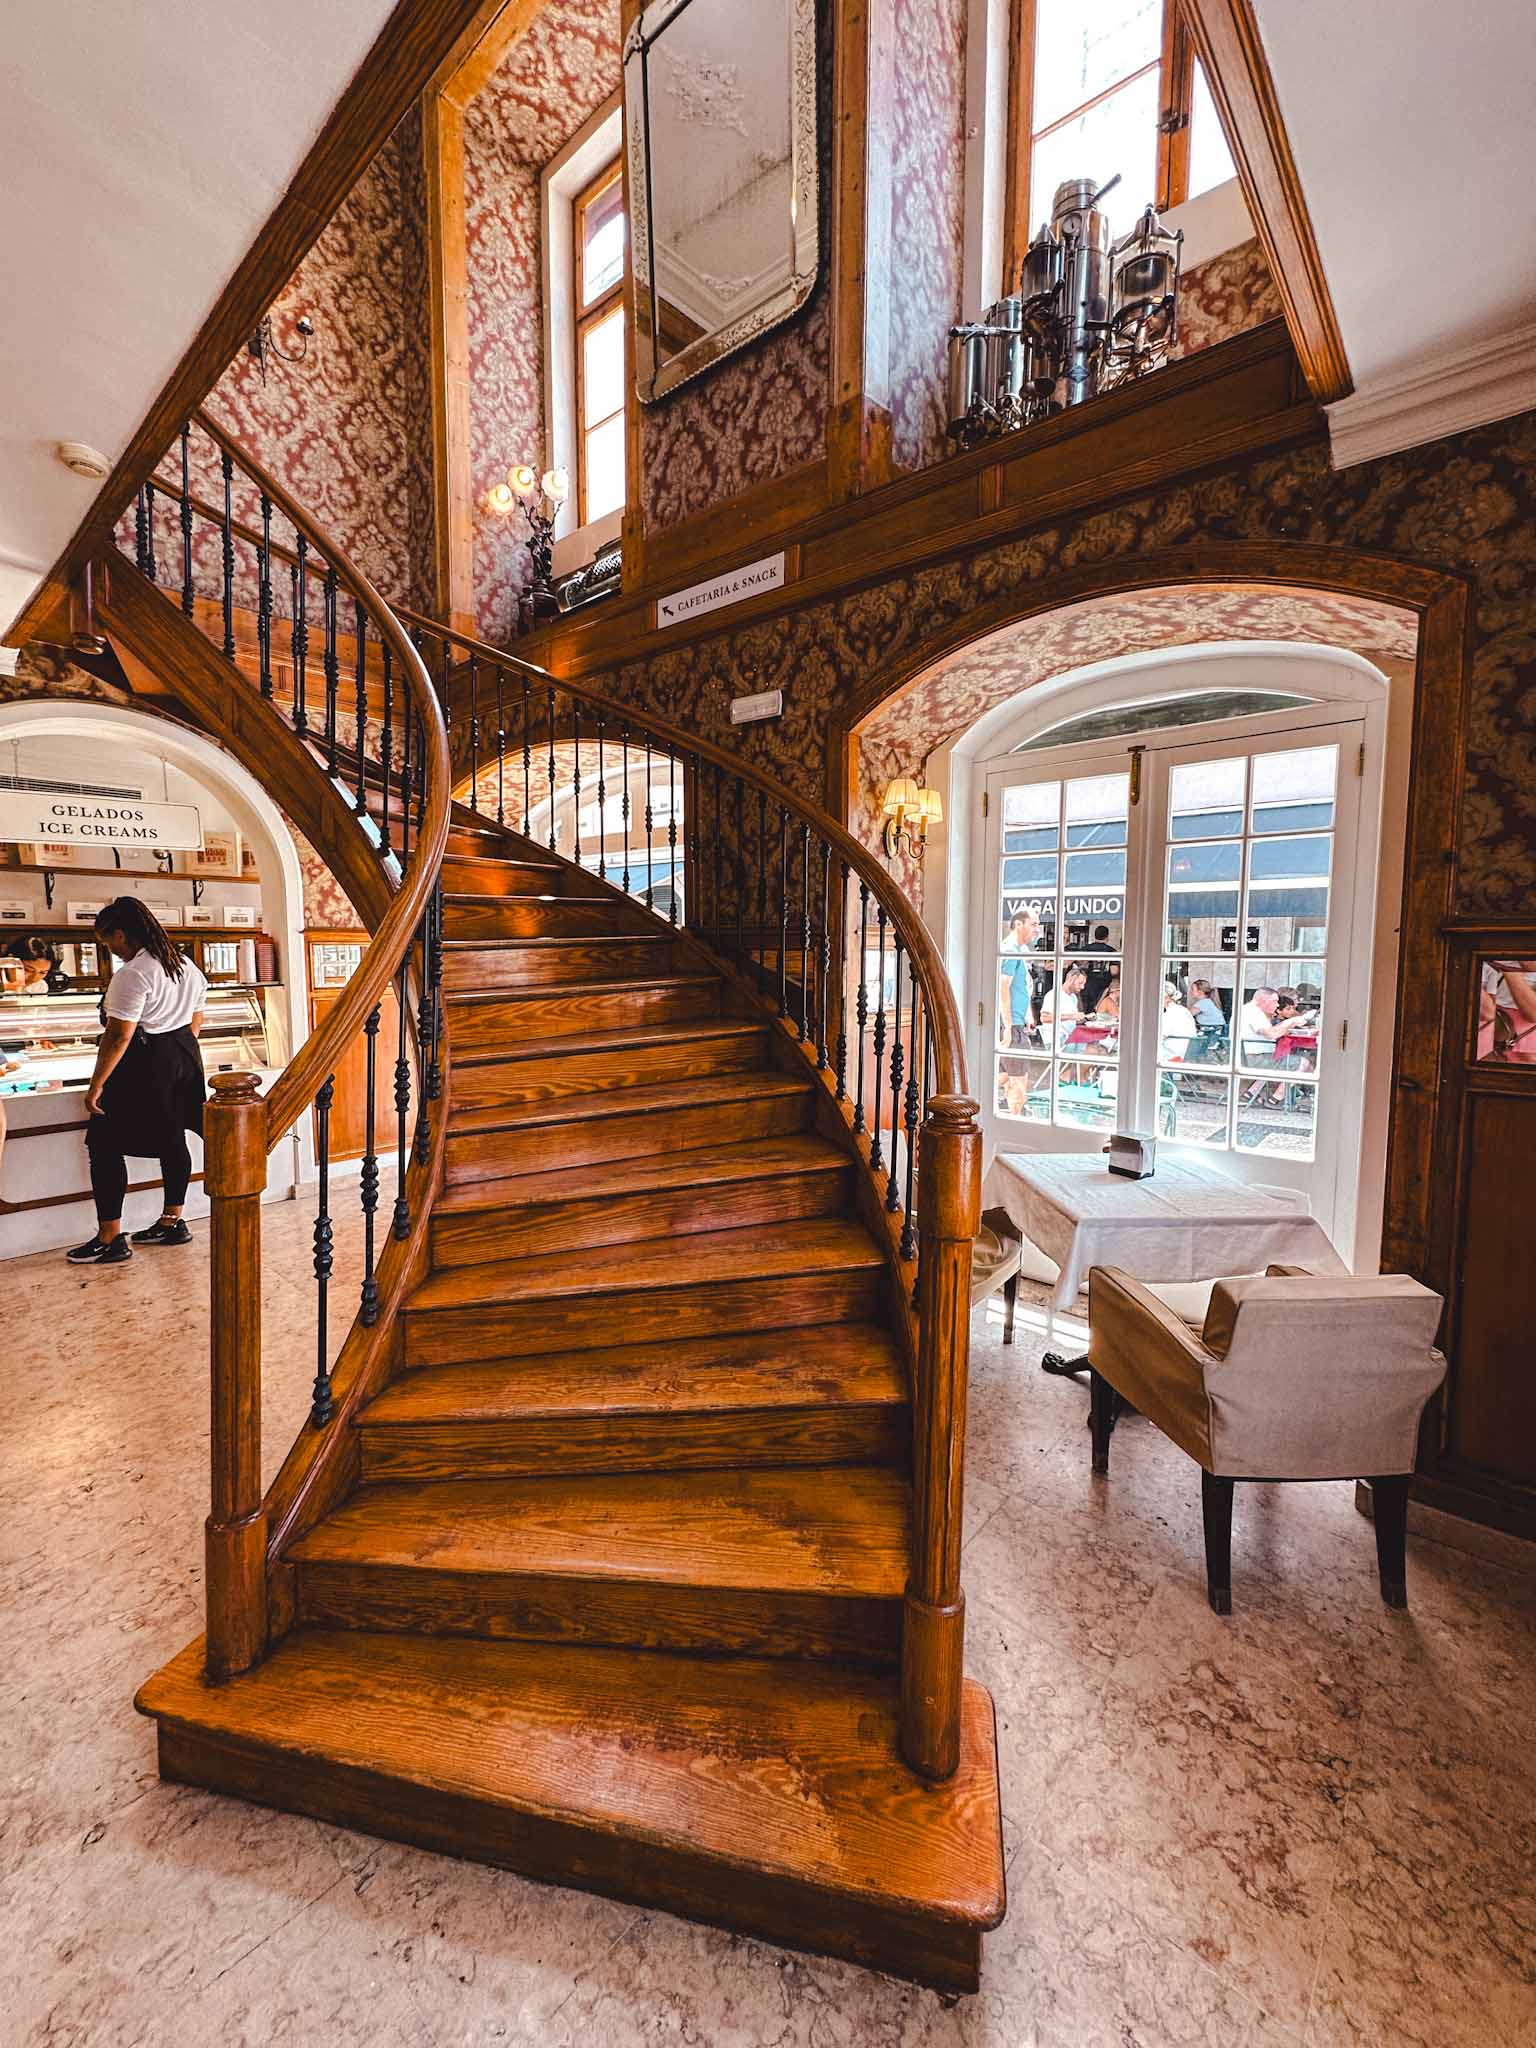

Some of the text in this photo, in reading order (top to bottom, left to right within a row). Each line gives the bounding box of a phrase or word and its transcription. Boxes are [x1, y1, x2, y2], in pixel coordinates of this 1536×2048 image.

[678, 567, 777, 612] CAFETARIA & SNACK
[51, 804, 144, 821] GELADOS
[39, 822, 159, 839] ICE CREAMS
[1007, 897, 1121, 915] VAGAUNDO
